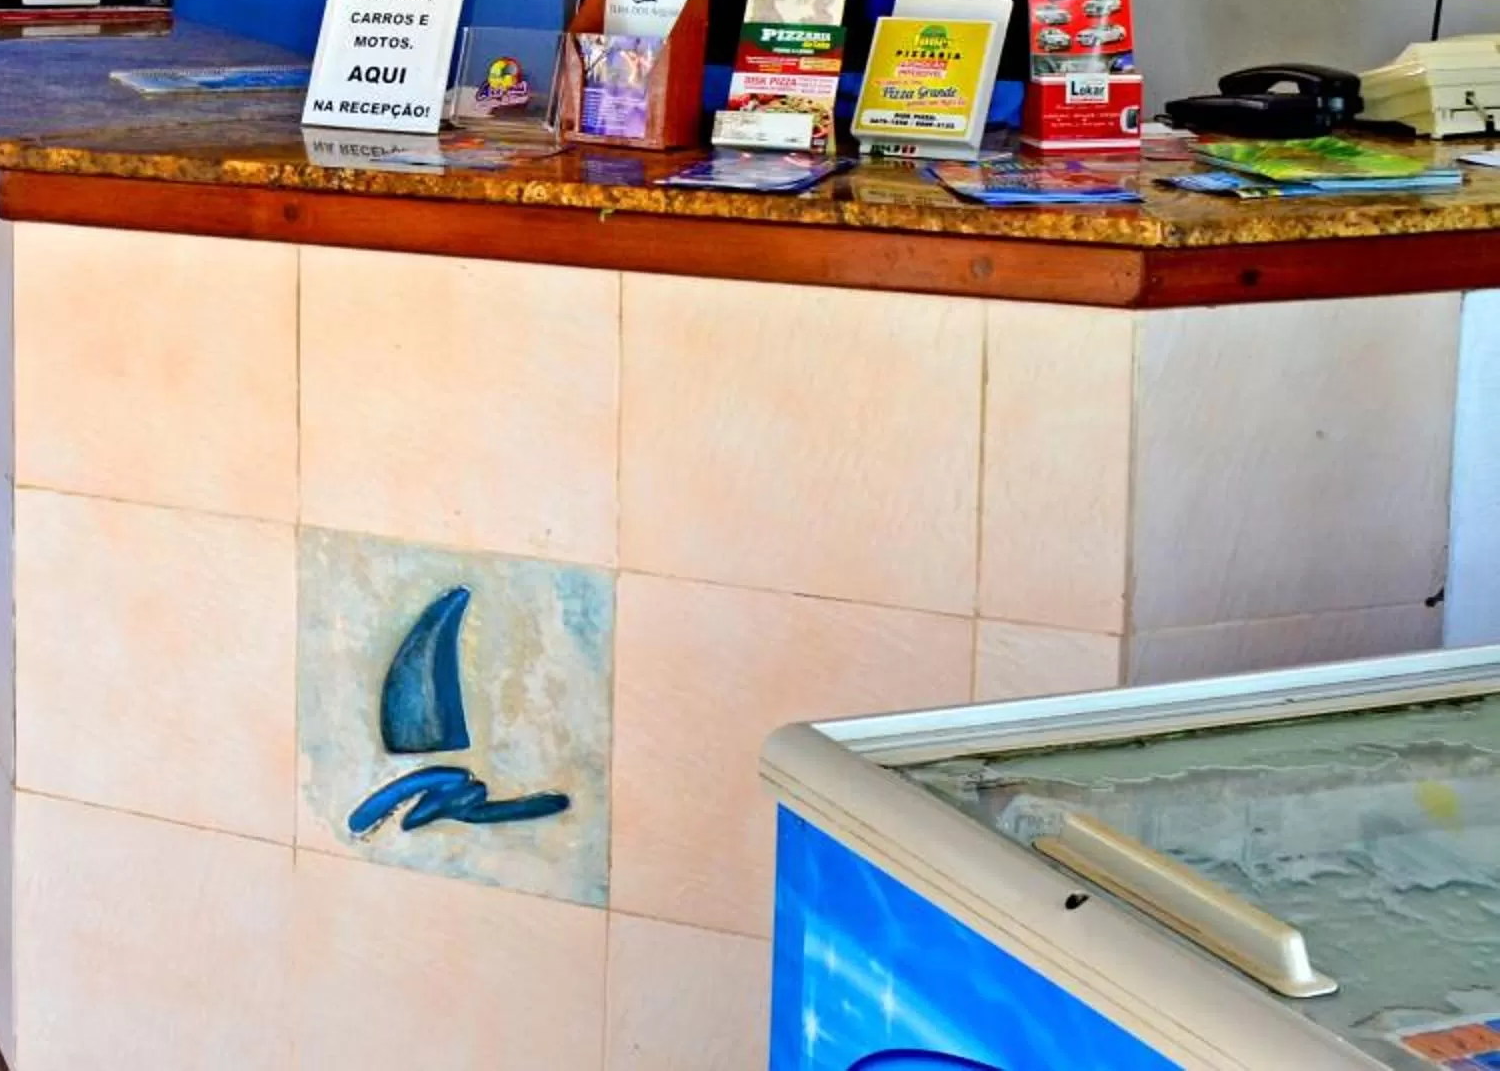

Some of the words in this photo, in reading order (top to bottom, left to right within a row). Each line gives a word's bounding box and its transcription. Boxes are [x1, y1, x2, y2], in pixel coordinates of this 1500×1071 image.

[351, 12, 414, 26] CARROS
[419, 14, 429, 26] E
[353, 35, 414, 50] MOTOS.
[347, 65, 407, 84] AQUI
[917, 85, 958, 99] Grande
[1070, 80, 1106, 97] Lokar
[312, 100, 334, 112] NA
[338, 100, 431, 119] RECEPÇÃO!
